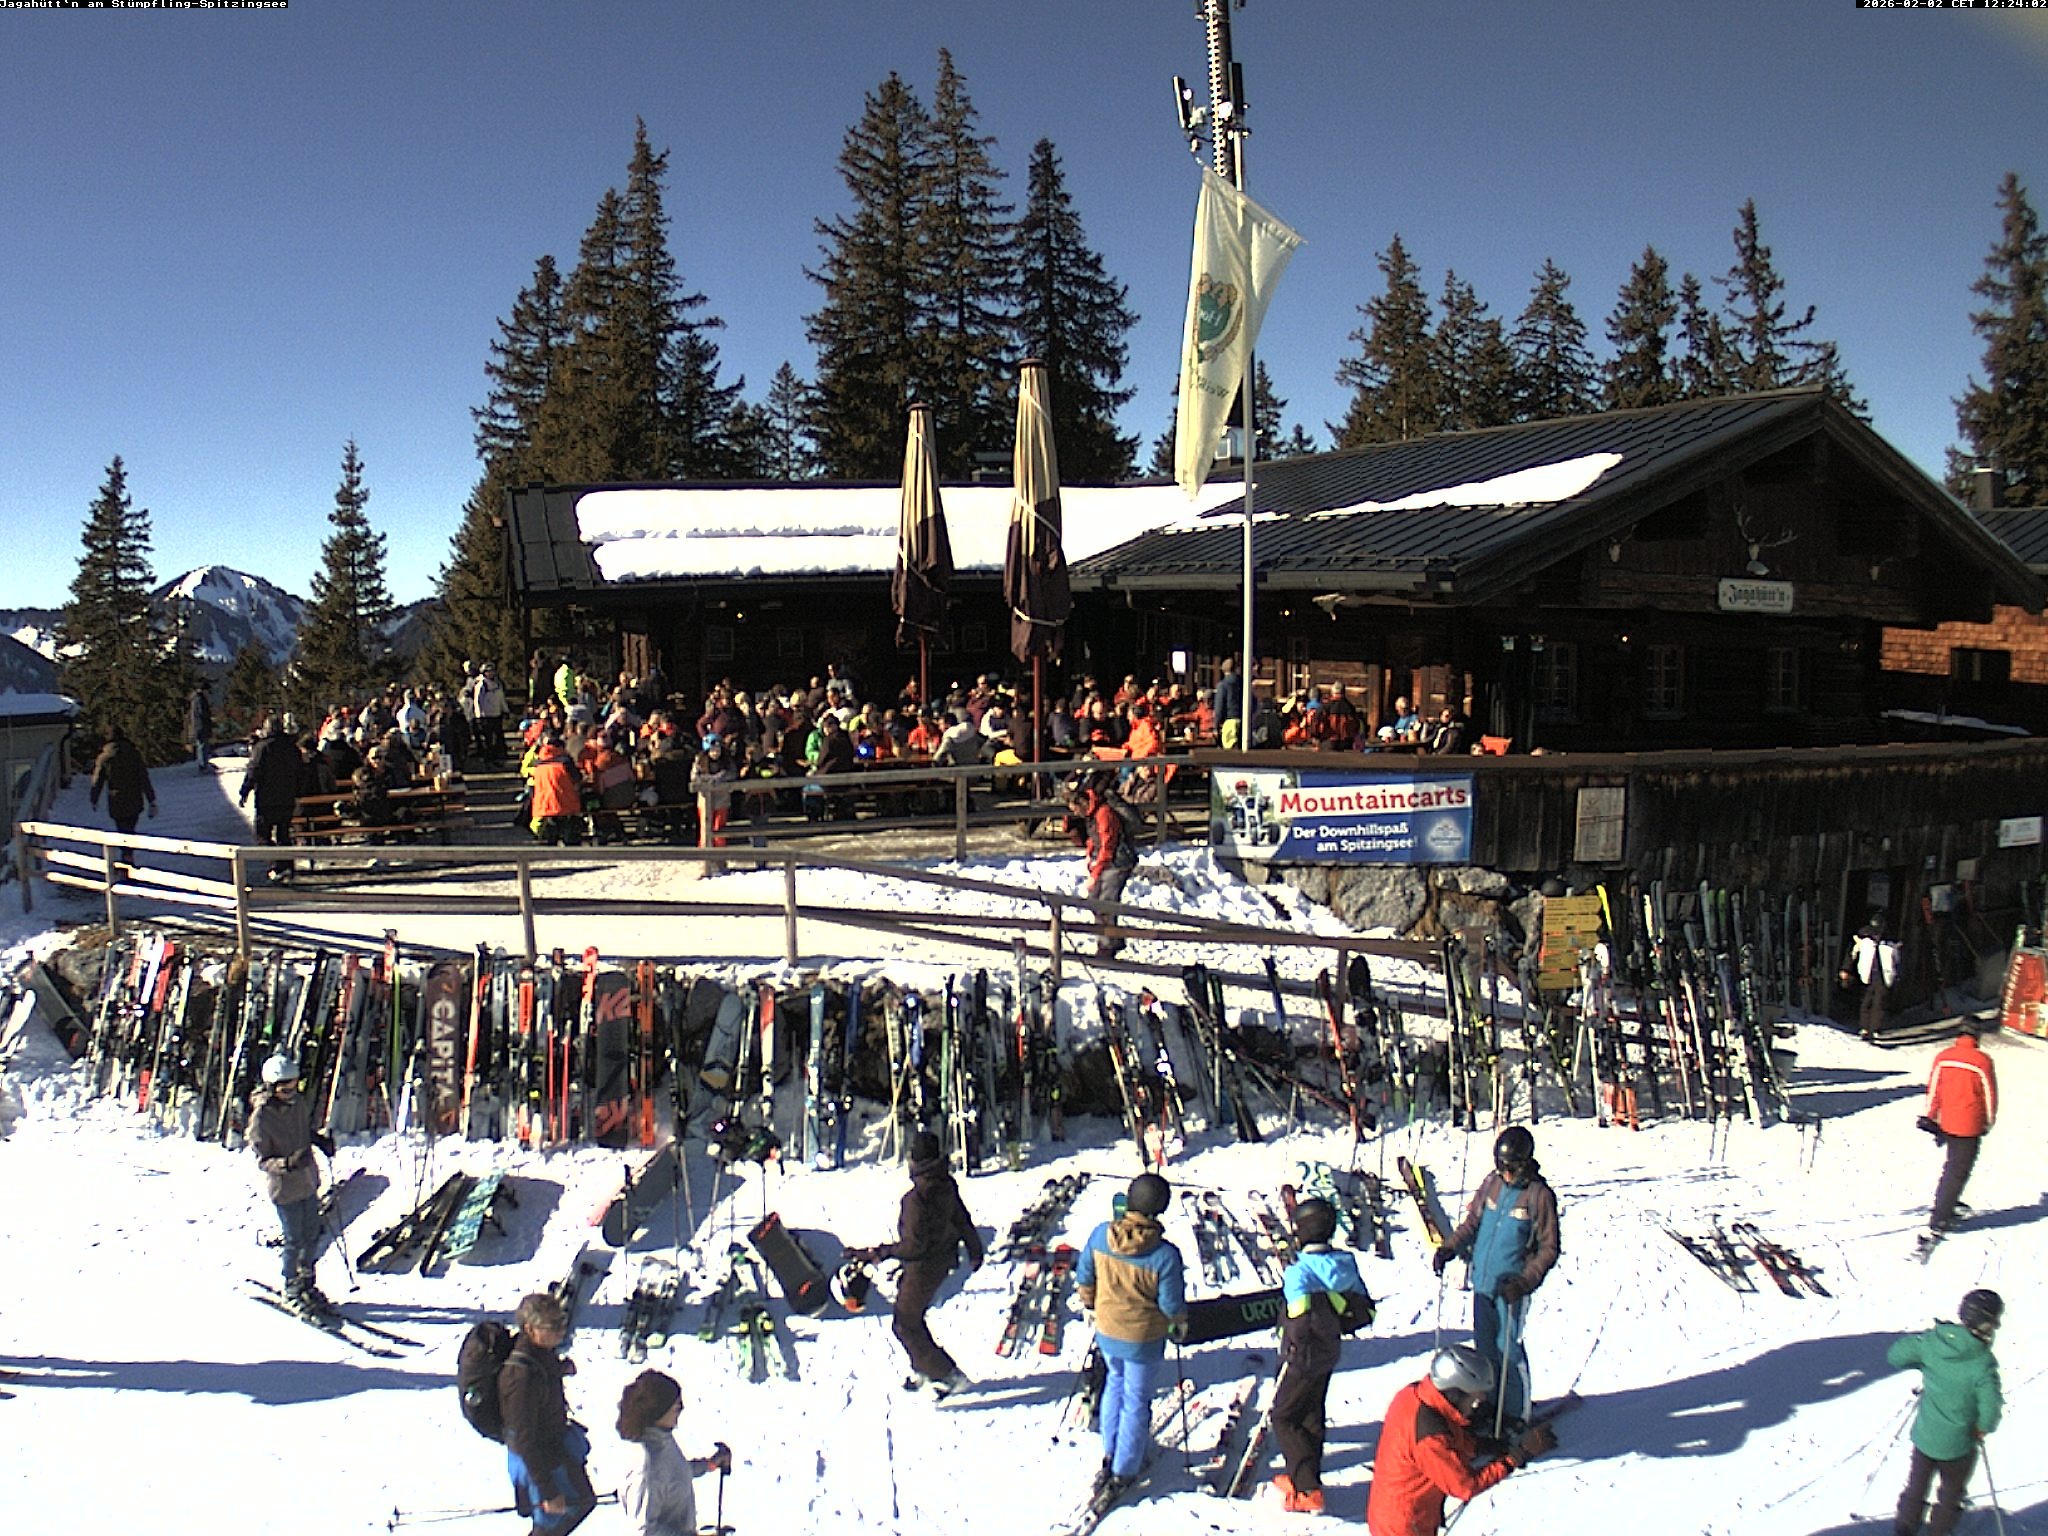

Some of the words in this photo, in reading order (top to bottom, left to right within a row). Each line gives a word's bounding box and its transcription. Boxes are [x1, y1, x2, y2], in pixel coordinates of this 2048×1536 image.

[1280, 786, 1467, 813] Mountaincarts
[1293, 826, 1316, 839] Der
[1319, 822, 1409, 838] Downhillspaß
[1317, 841, 1338, 852] am
